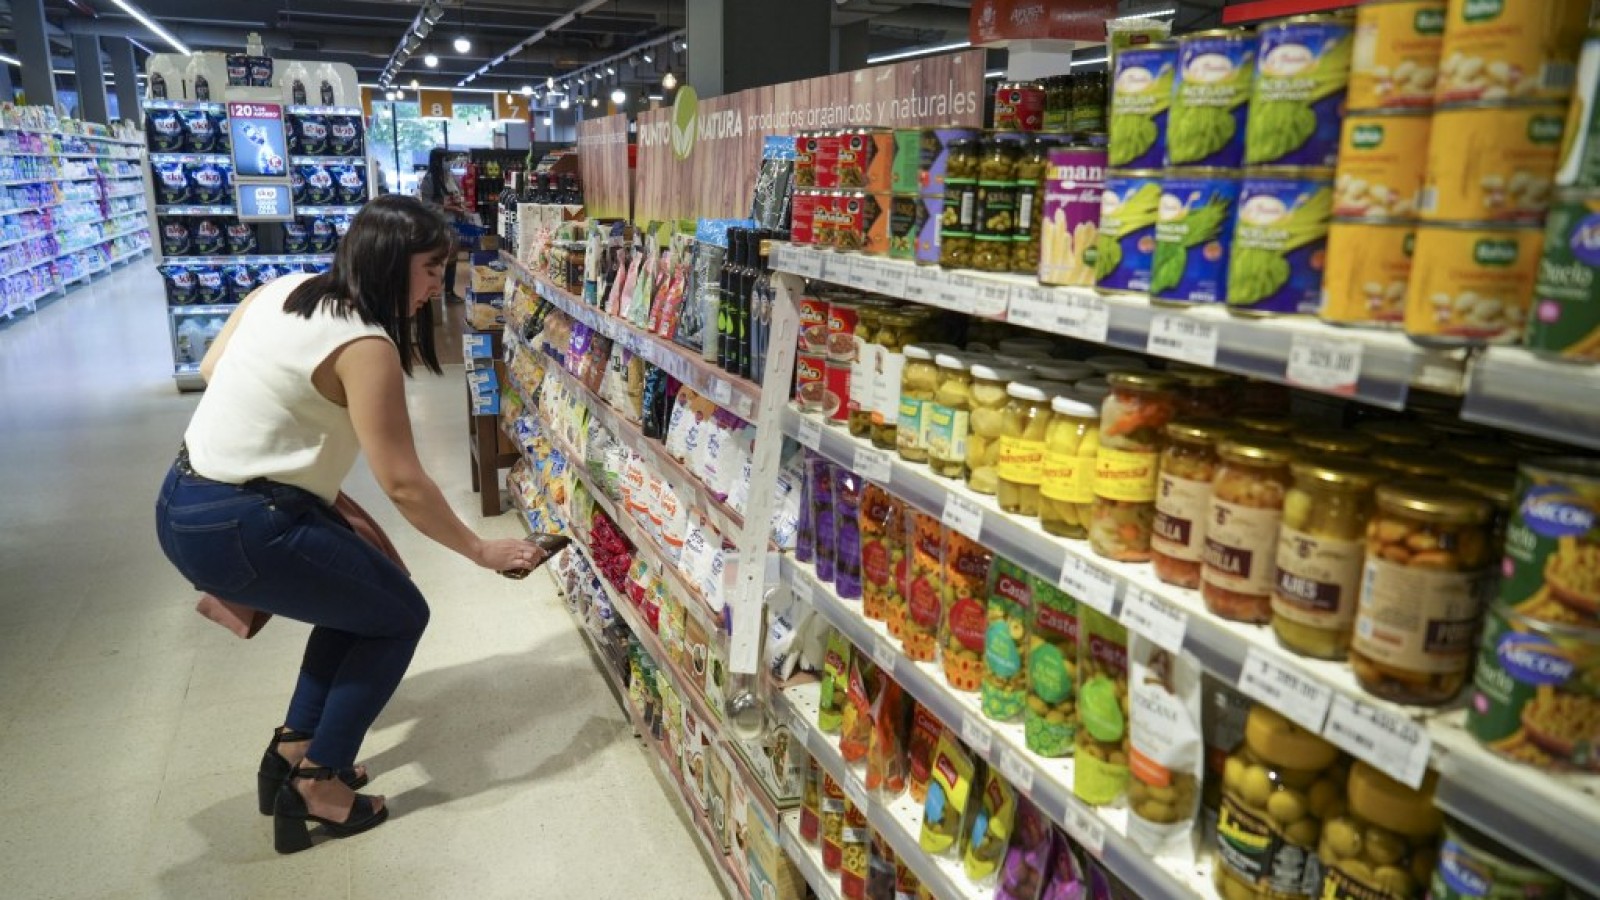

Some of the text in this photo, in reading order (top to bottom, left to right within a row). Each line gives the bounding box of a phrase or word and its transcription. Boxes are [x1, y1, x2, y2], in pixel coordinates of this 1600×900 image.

[431, 103, 443, 116] 8
[747, 80, 977, 132] productos orgánicos y naturales
[640, 108, 743, 147] PUNTO NATURA
